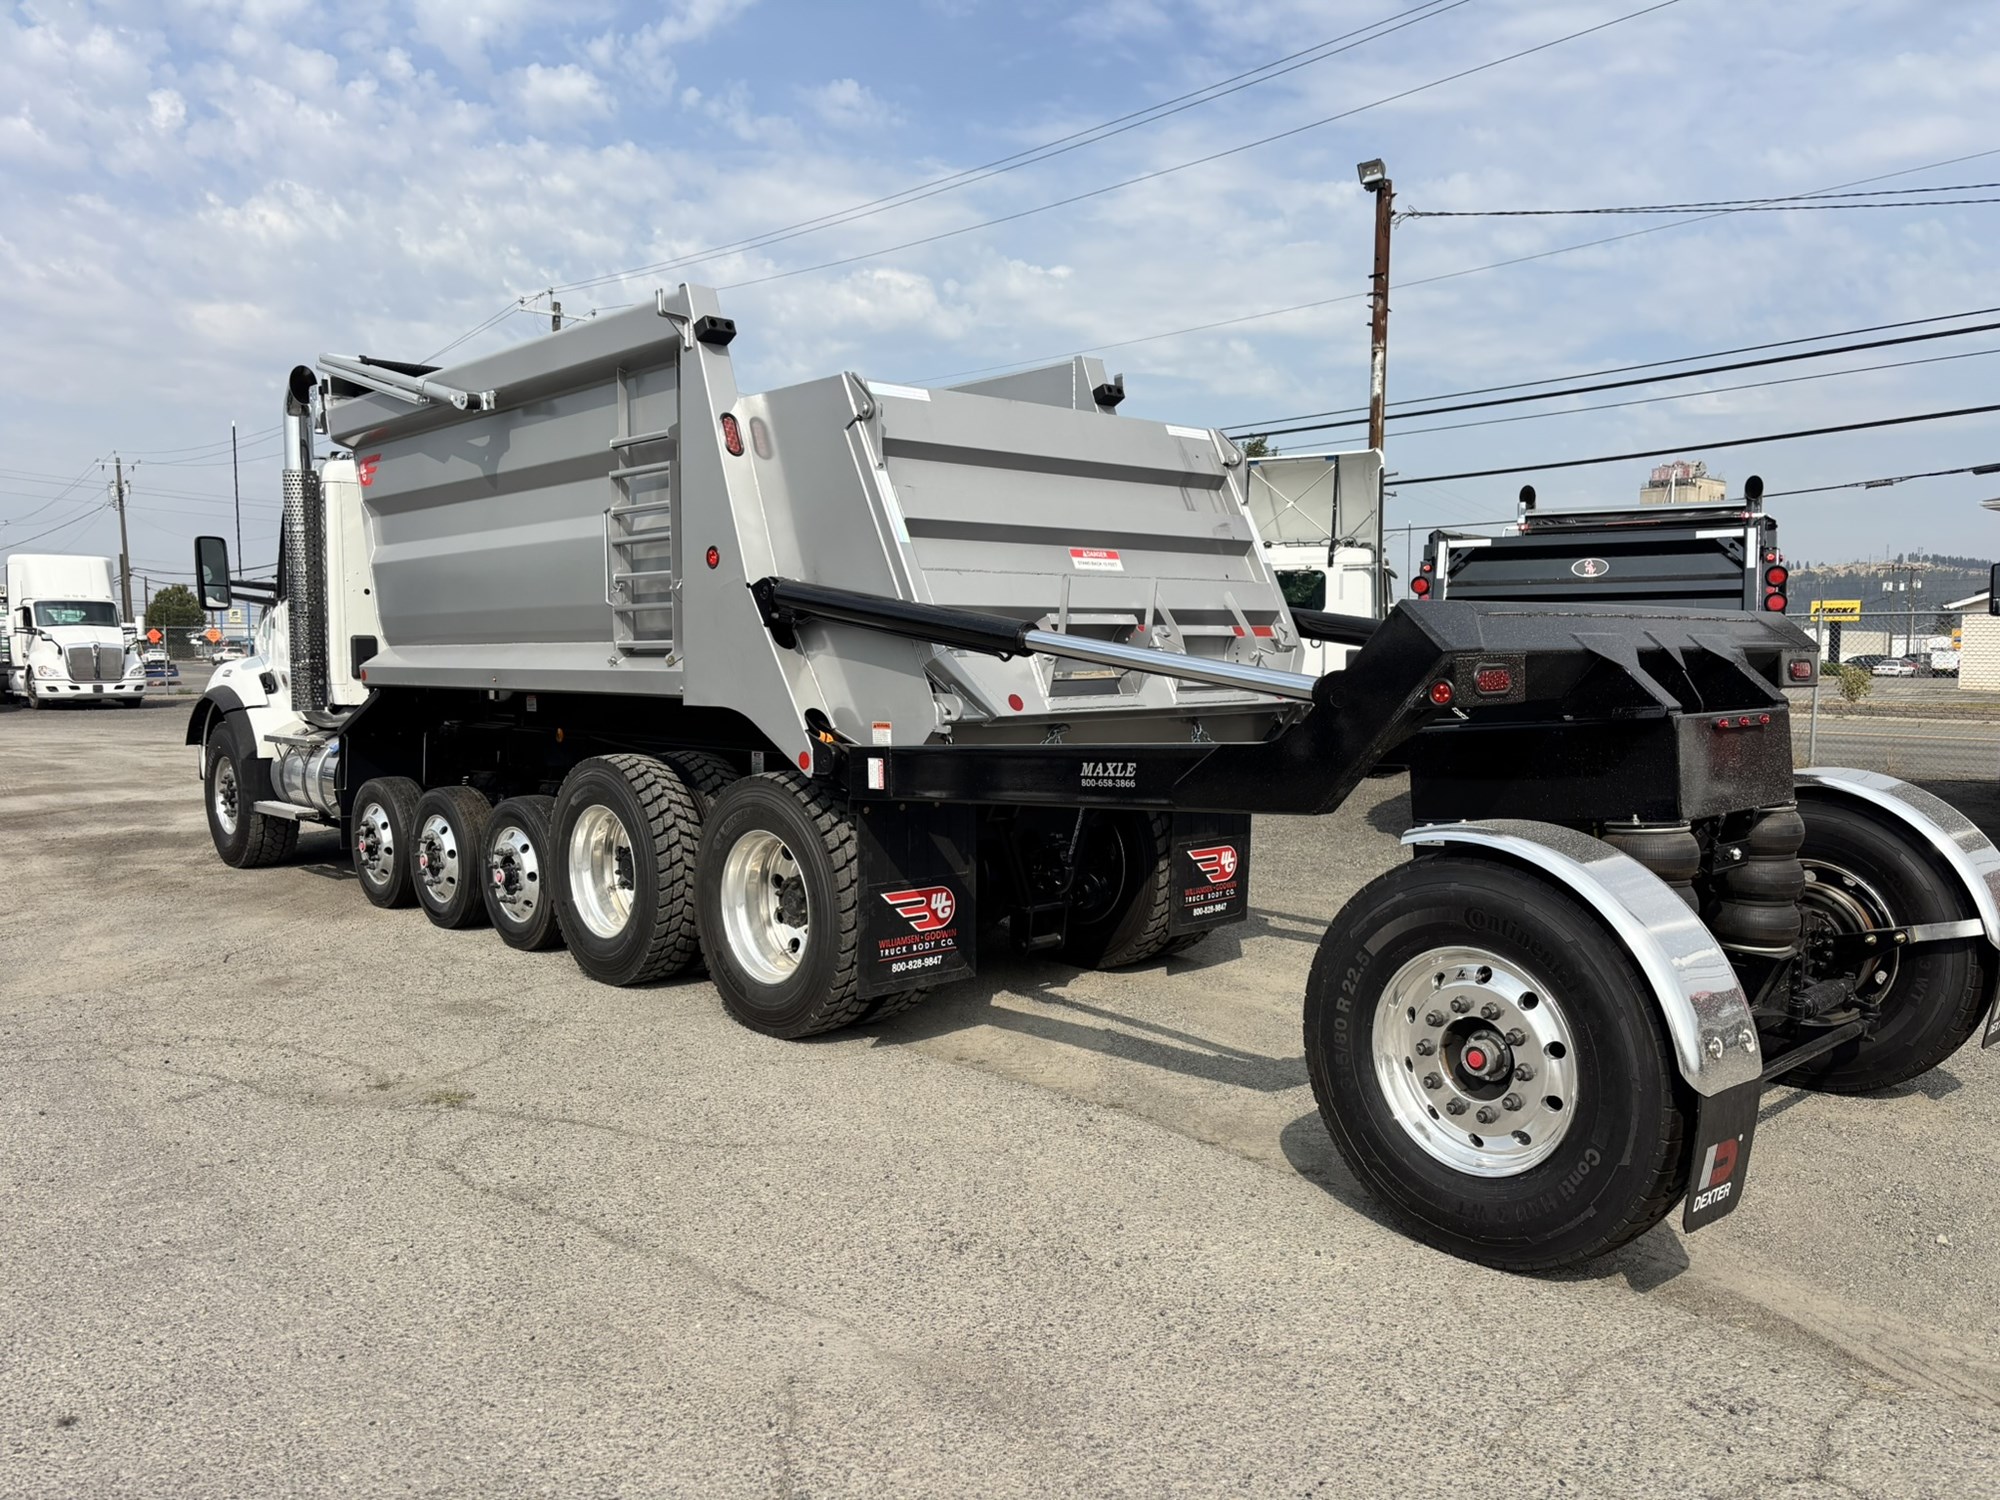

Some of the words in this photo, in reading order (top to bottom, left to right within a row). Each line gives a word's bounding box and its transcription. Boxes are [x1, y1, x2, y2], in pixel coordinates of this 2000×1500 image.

[1080, 762, 1136, 777] MAXLE
[1081, 778, 1136, 788] 800-658-3866
[879, 934, 920, 949] WILLIAMSEN
[924, 928, 957, 942] GODWIN
[880, 946, 907, 957] TRUCK
[912, 941, 935, 952] BODY
[891, 955, 942, 973] 800-828-9847
[1341, 950, 1371, 996] 22.5
[1335, 996, 1352, 1013] R
[1556, 1147, 1601, 1201] Conti
[1692, 1182, 1732, 1213] DEXTER
